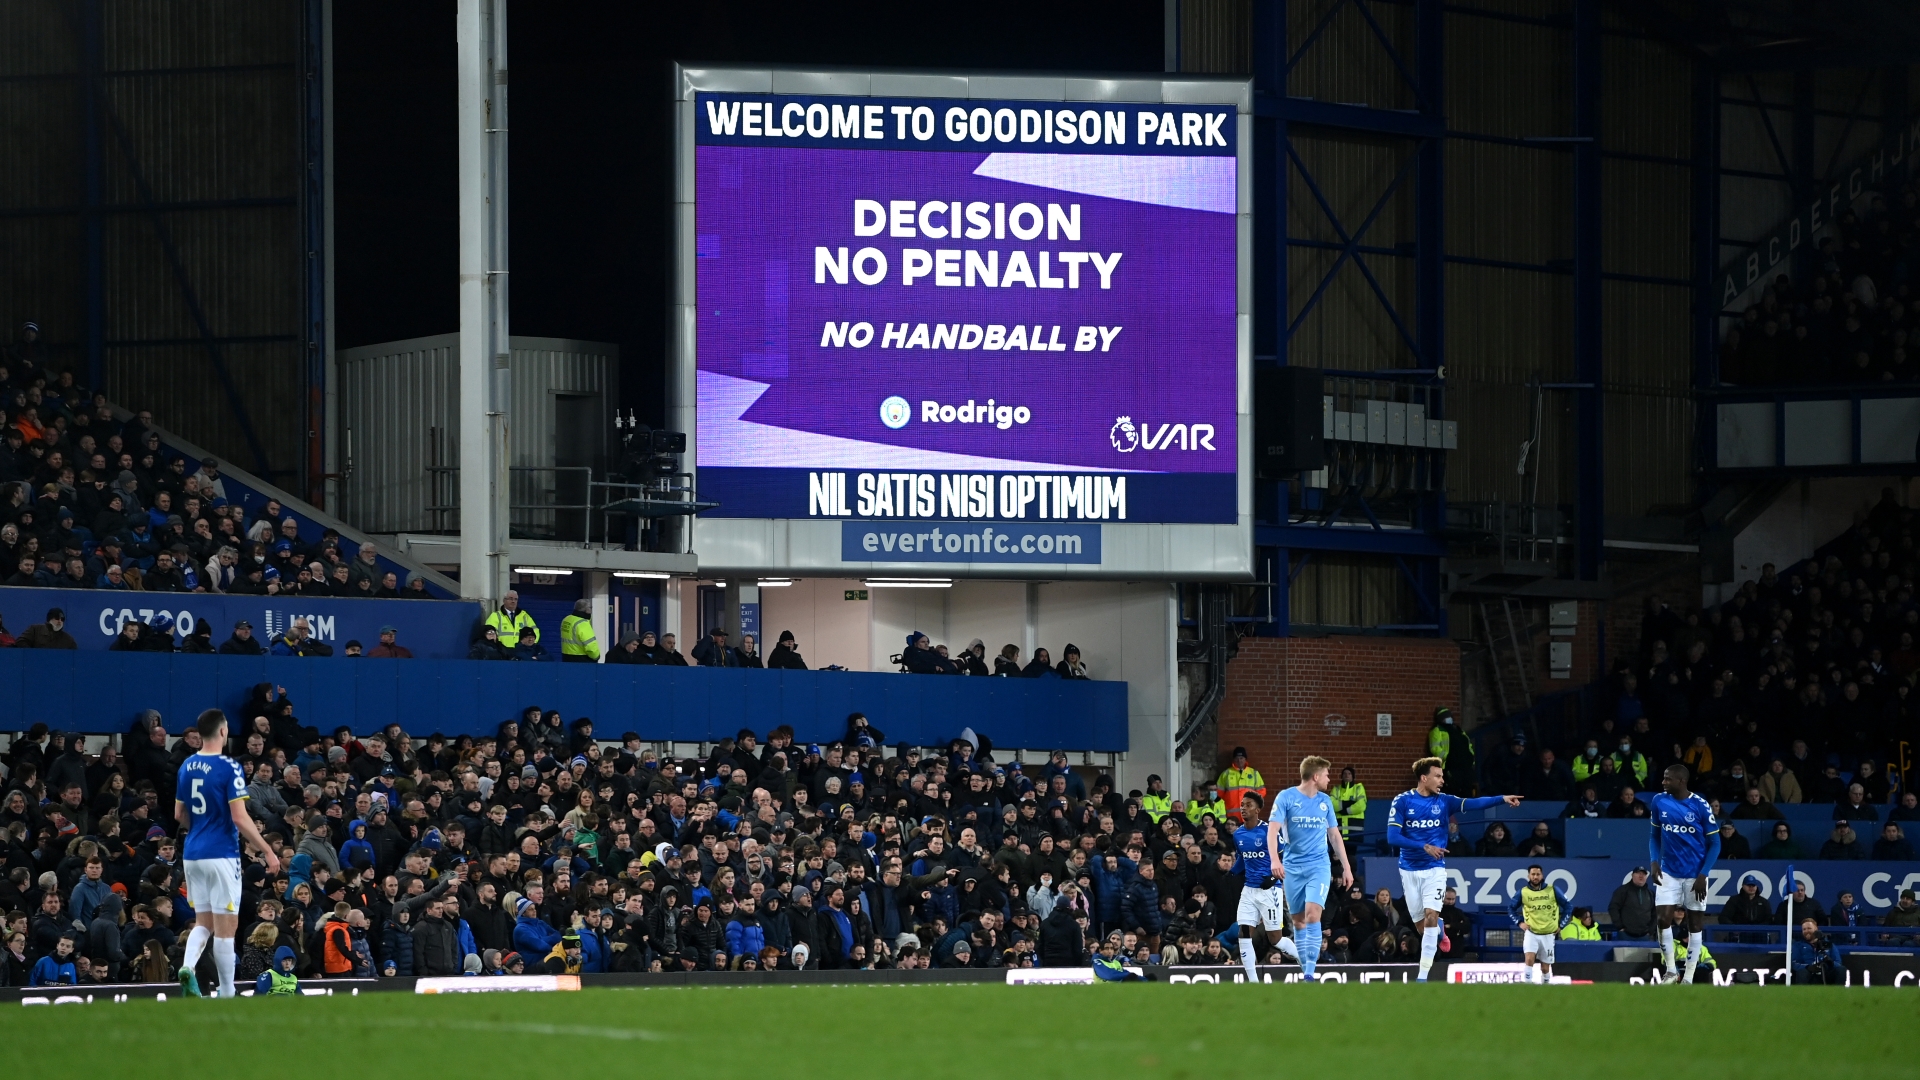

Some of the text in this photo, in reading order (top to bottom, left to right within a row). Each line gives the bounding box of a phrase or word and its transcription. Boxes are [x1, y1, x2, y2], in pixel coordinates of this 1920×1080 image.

[706, 101, 1228, 146] WELCOME TO GOODISON PARK
[854, 199, 1081, 241] DECISION
[814, 246, 1123, 290] NO PENALTY
[820, 321, 1123, 352] NO HANDBALL BY
[921, 398, 1031, 430] Rodrigo
[1140, 423, 1217, 451] VAR
[809, 472, 1127, 520] NIL SATIS NISI OPTIMUM
[862, 527, 1082, 555] evertonfc.com
[186, 761, 212, 775] KEANE
[191, 778, 207, 815] 5
[1405, 819, 1441, 828] CAZOO
[1267, 908, 1276, 921] 11
